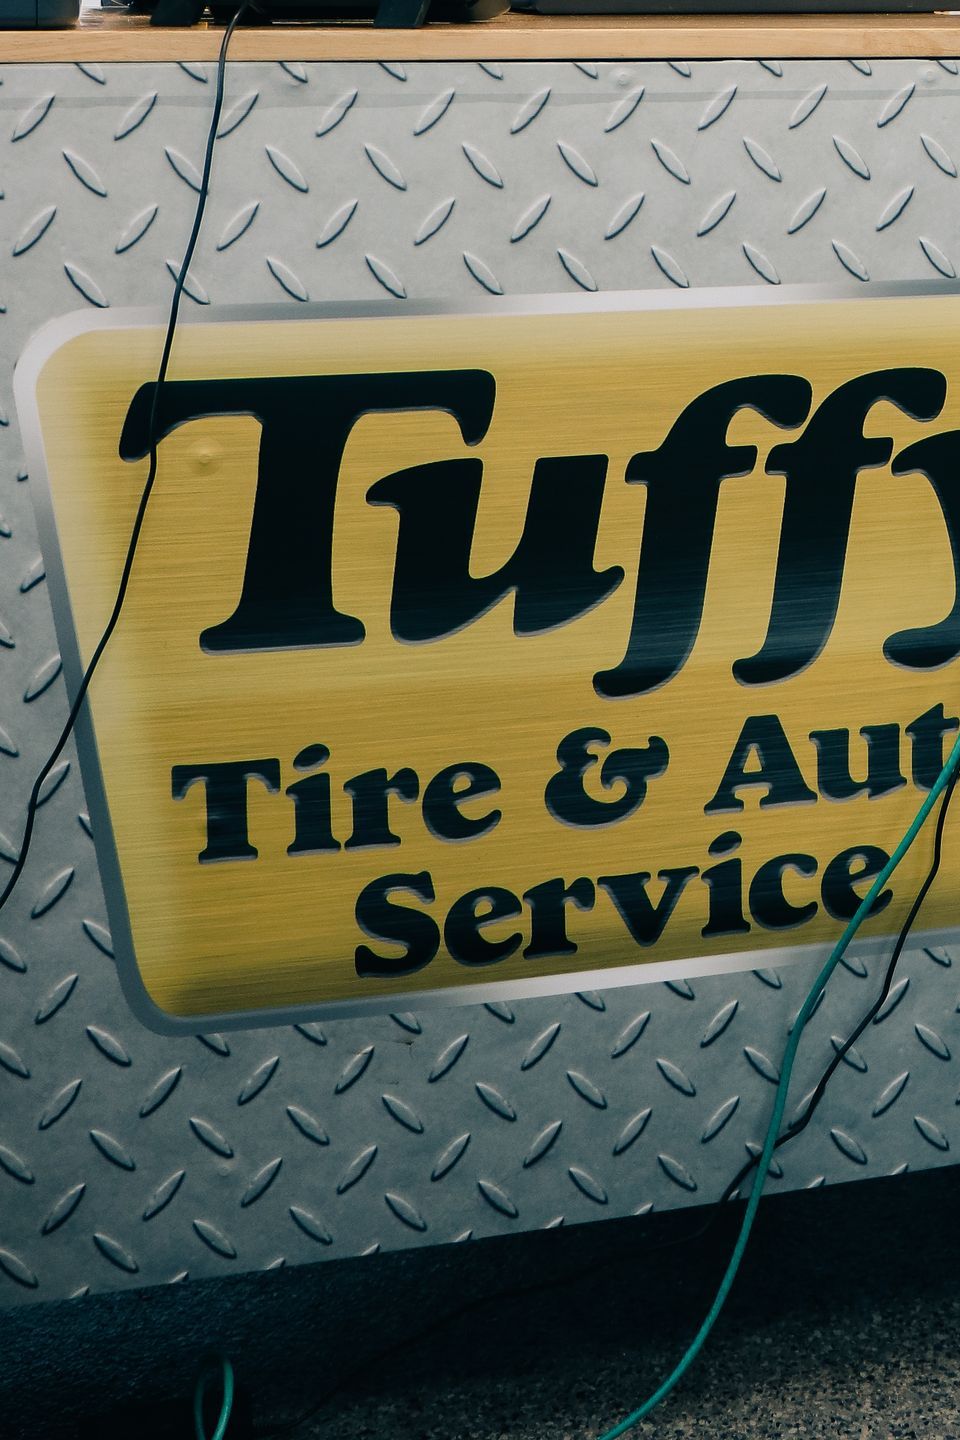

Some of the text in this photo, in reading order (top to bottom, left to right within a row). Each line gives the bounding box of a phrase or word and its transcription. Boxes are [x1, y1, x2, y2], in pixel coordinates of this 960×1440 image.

[171, 742, 502, 865] Tire
[545, 726, 670, 829] &
[354, 830, 894, 979] Service
